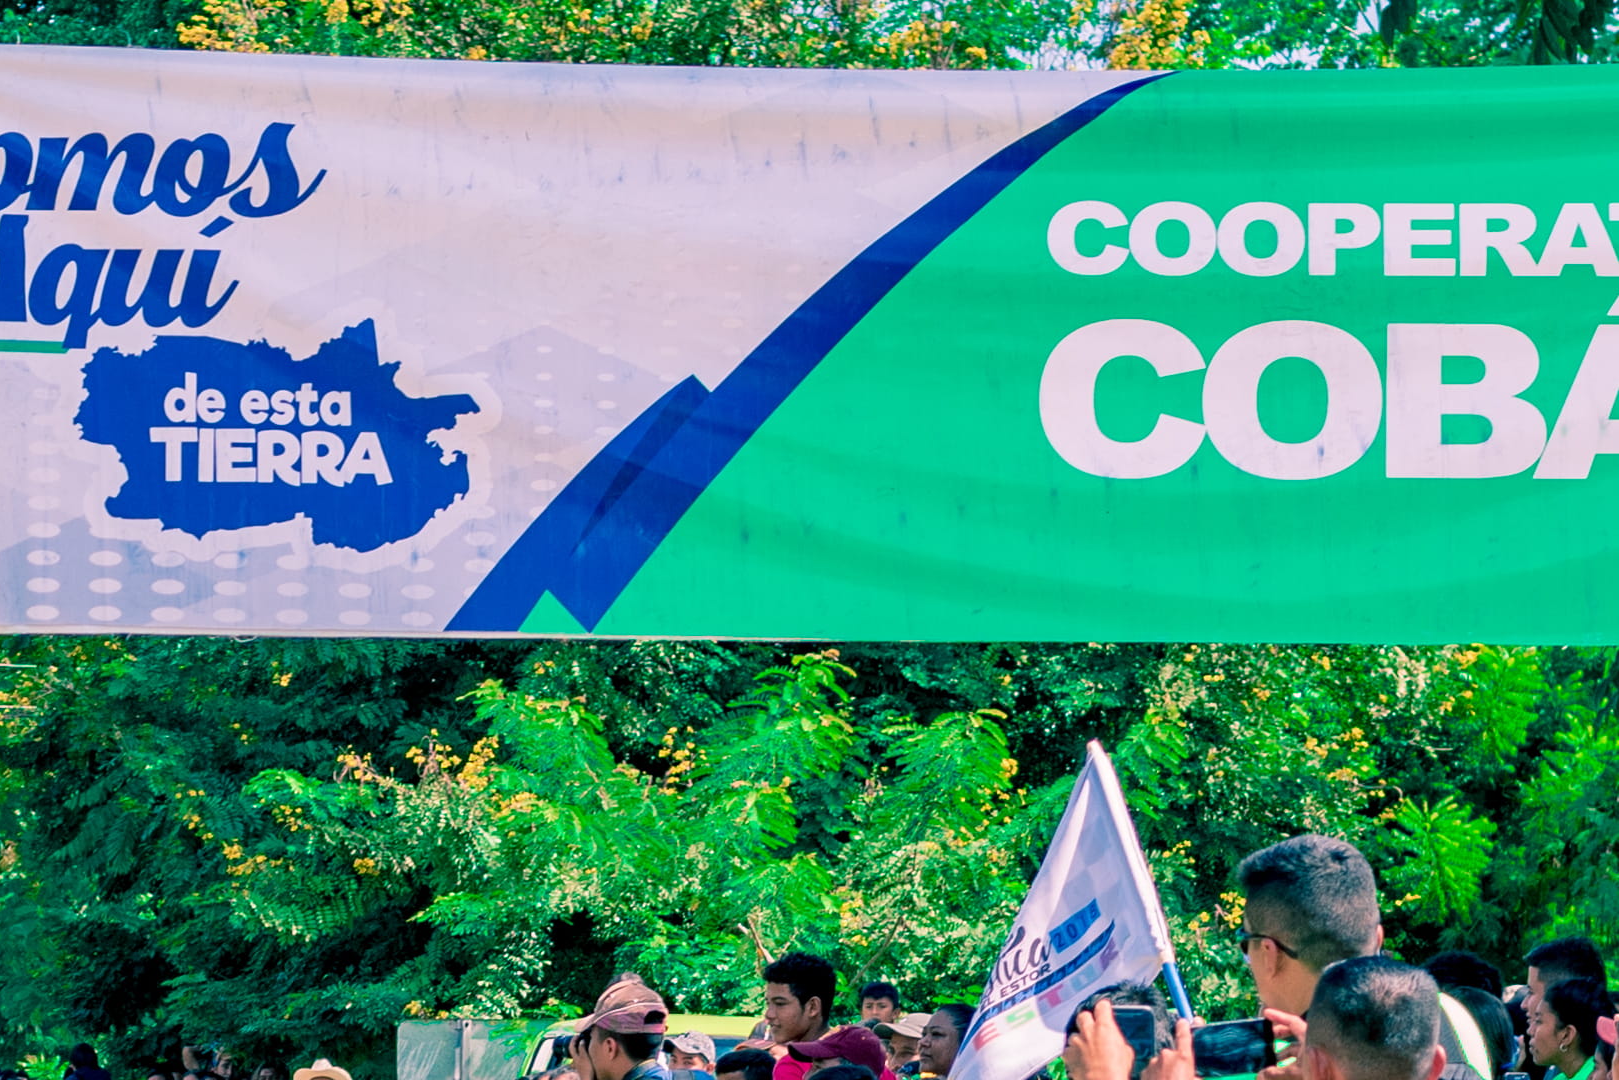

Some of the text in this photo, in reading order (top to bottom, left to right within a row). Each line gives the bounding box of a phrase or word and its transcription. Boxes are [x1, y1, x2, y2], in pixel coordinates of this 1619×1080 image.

[1046, 200, 1619, 277] COOPERA
[163, 372, 352, 427] de esta
[150, 426, 393, 487] TIERRA
[1053, 904, 1100, 951] 2018
[1000, 962, 1052, 997] ESTOR
